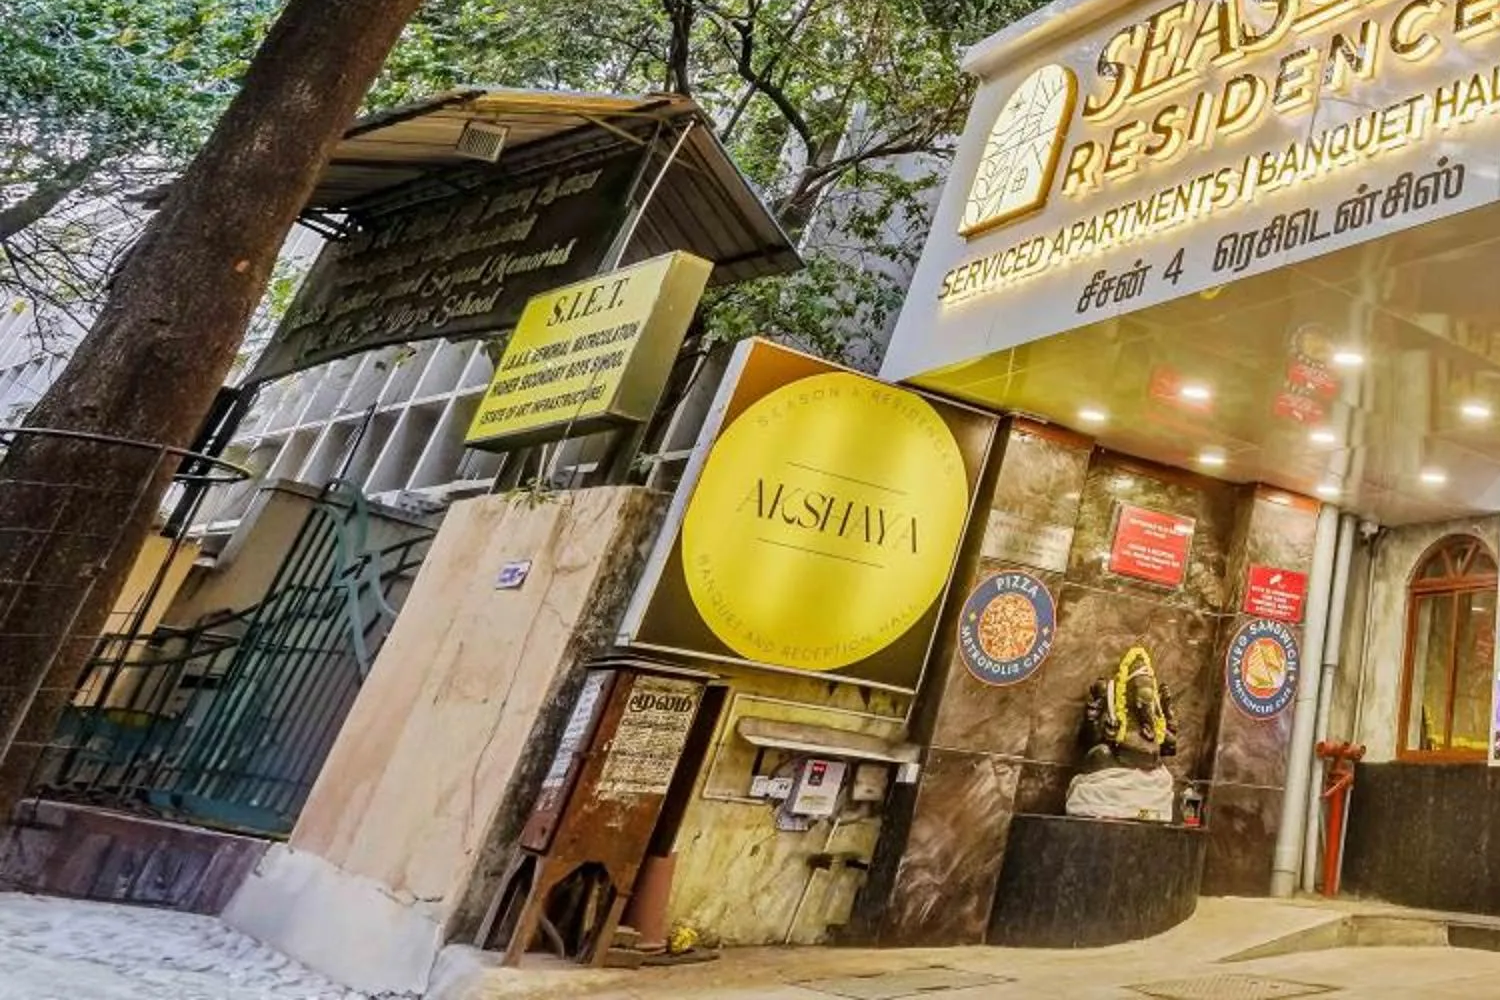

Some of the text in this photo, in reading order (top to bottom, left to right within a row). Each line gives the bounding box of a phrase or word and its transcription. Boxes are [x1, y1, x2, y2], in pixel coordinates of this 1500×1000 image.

[937, 236, 1048, 303] SERVICED
[1047, 168, 1232, 266] APARTMENTS
[1256, 97, 1430, 190] BANQUET
[546, 278, 630, 327] S.I.E.T.
[1076, 258, 1152, 313] சீசன்
[1162, 247, 1185, 286] 4
[735, 478, 920, 555] AKSHAYA
[995, 575, 1039, 599] PIZZA
[961, 625, 1021, 676] METROPOLIS
